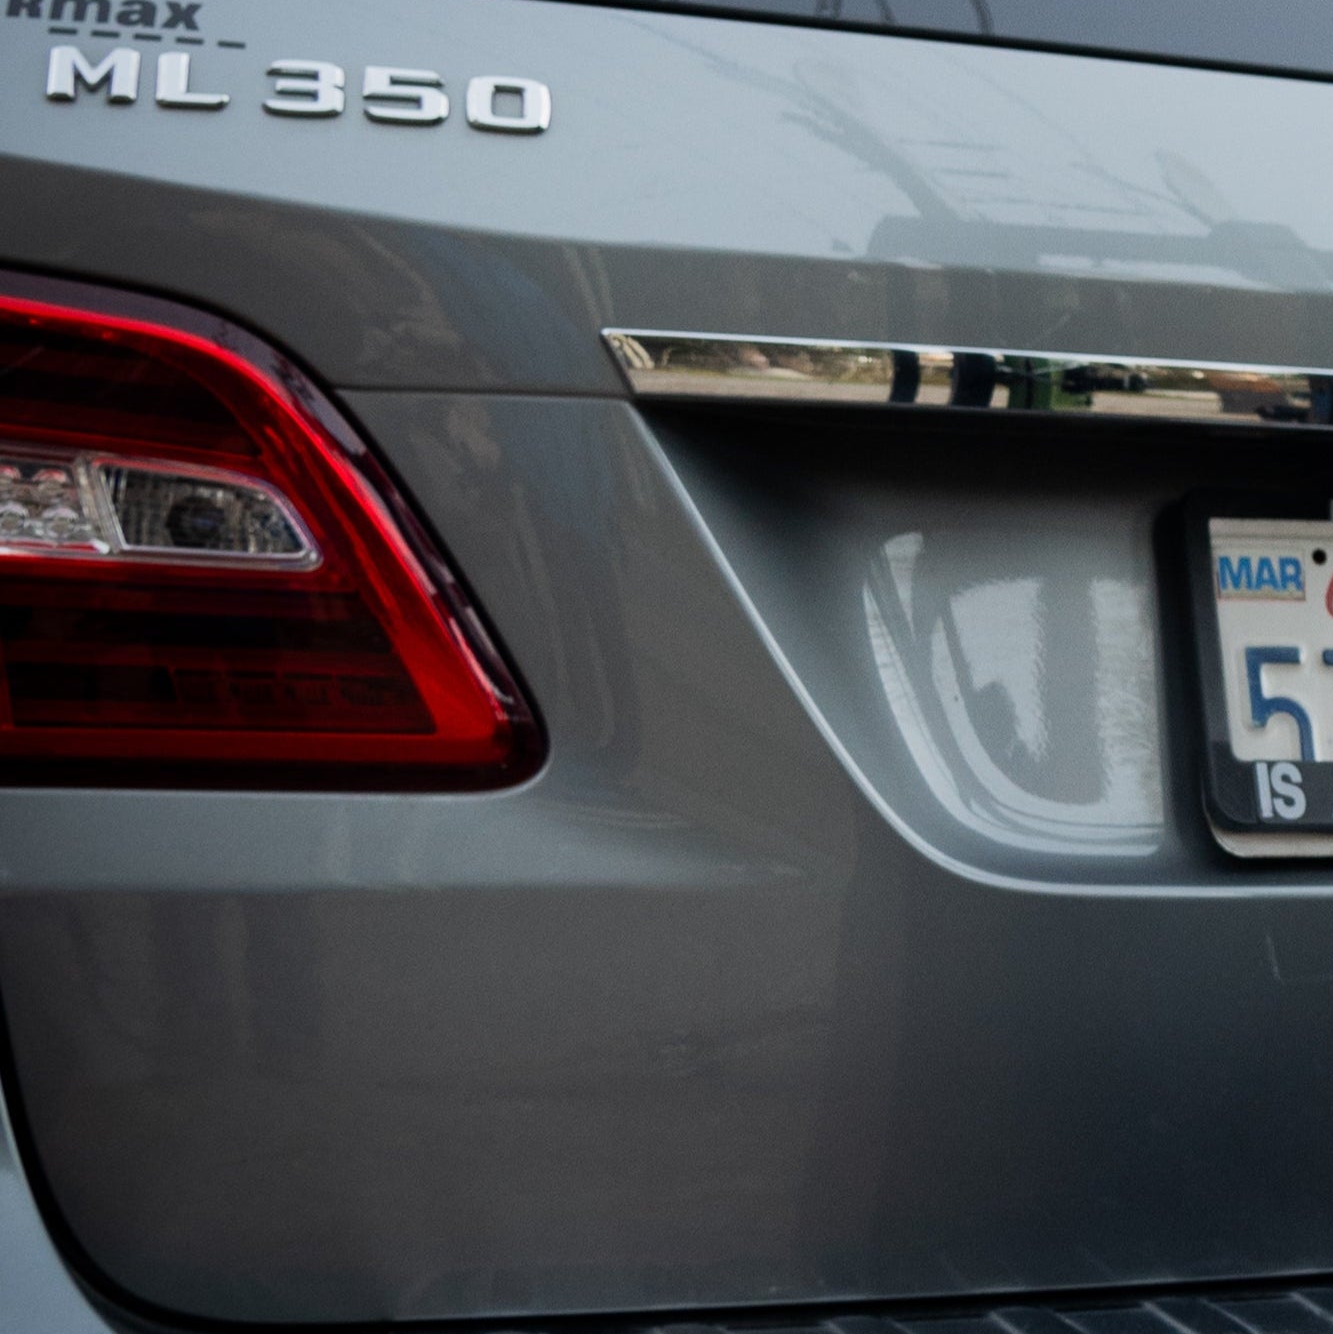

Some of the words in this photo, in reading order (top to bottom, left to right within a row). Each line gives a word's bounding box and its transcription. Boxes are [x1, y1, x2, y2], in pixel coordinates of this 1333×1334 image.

[46, 44, 231, 111] ML
[262, 58, 552, 135] 350
[1216, 555, 1304, 592] MAR
[1255, 762, 1307, 820] IS
